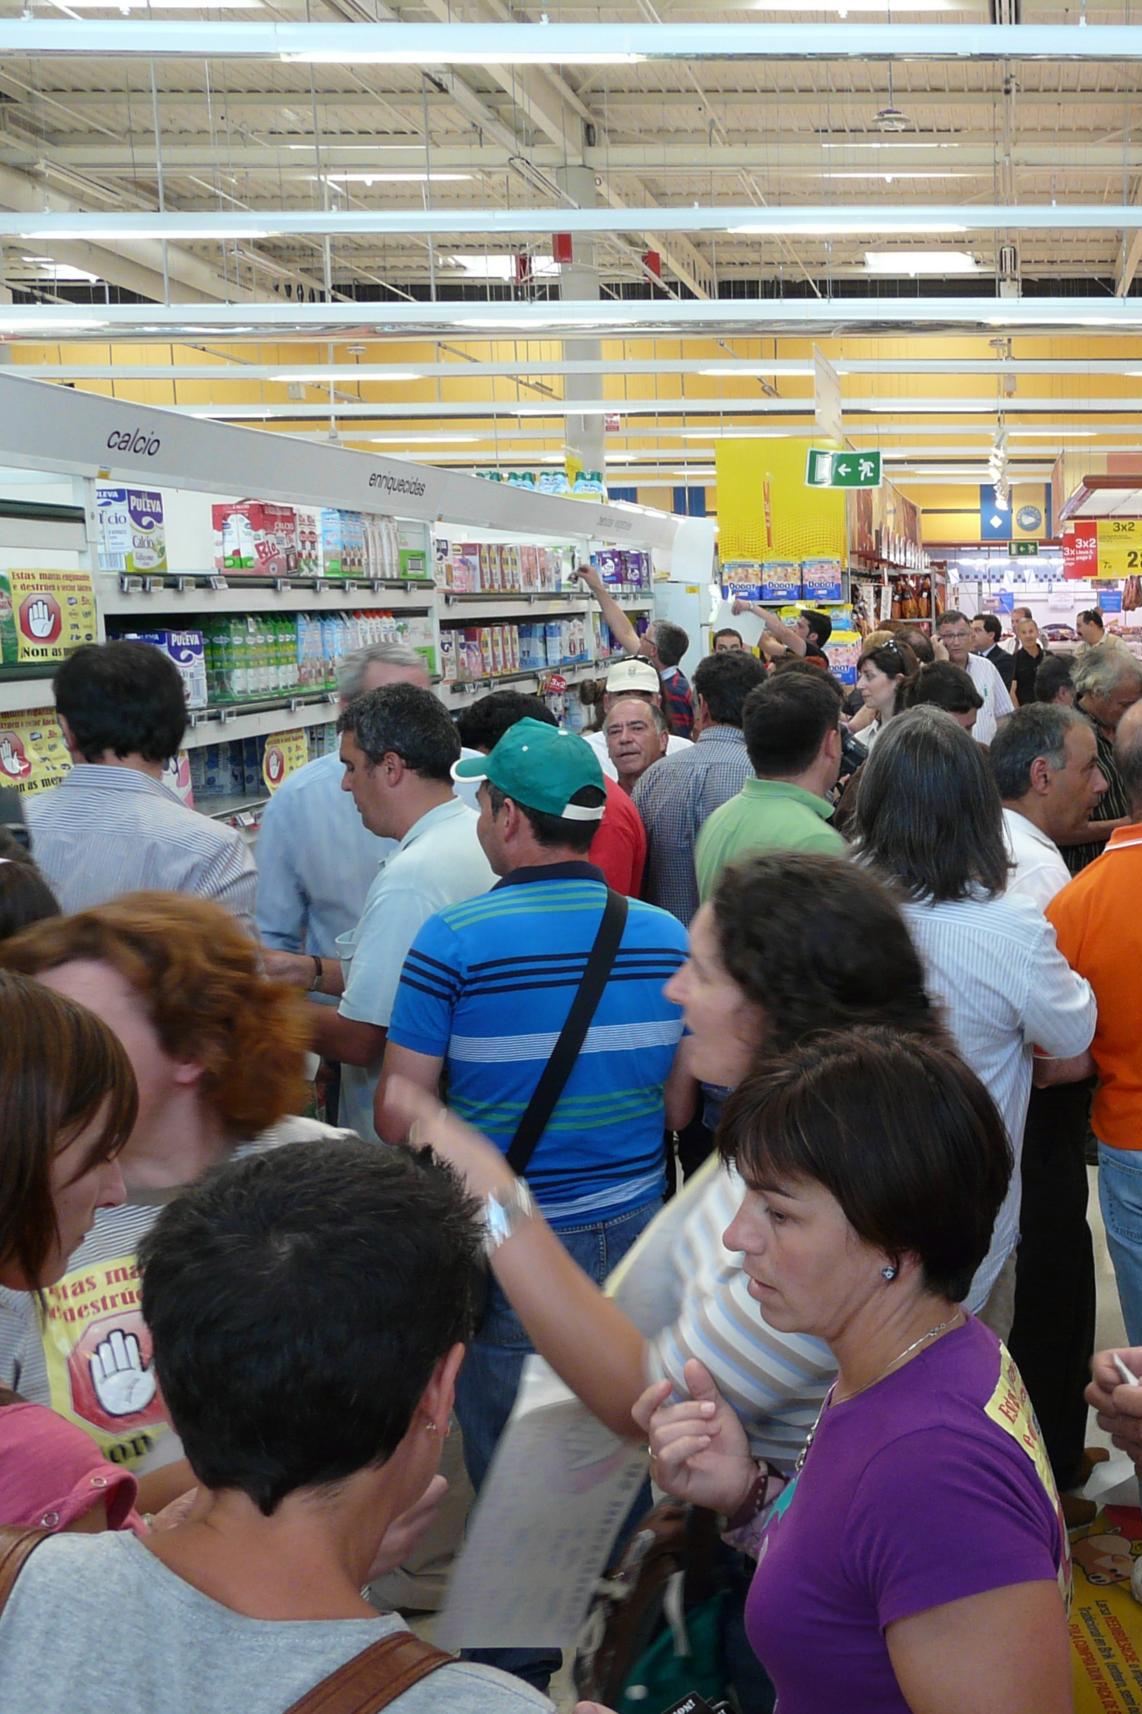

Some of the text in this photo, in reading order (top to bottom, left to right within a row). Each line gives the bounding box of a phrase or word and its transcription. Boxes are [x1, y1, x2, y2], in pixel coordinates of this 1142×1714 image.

[107, 427, 160, 457] calcio
[130, 495, 162, 513] PULEVA
[1112, 521, 1136, 532] 3x2
[1075, 538, 1097, 548] 3x2
[1064, 547, 1076, 556] 3x
[171, 633, 201, 647] PULEVA
